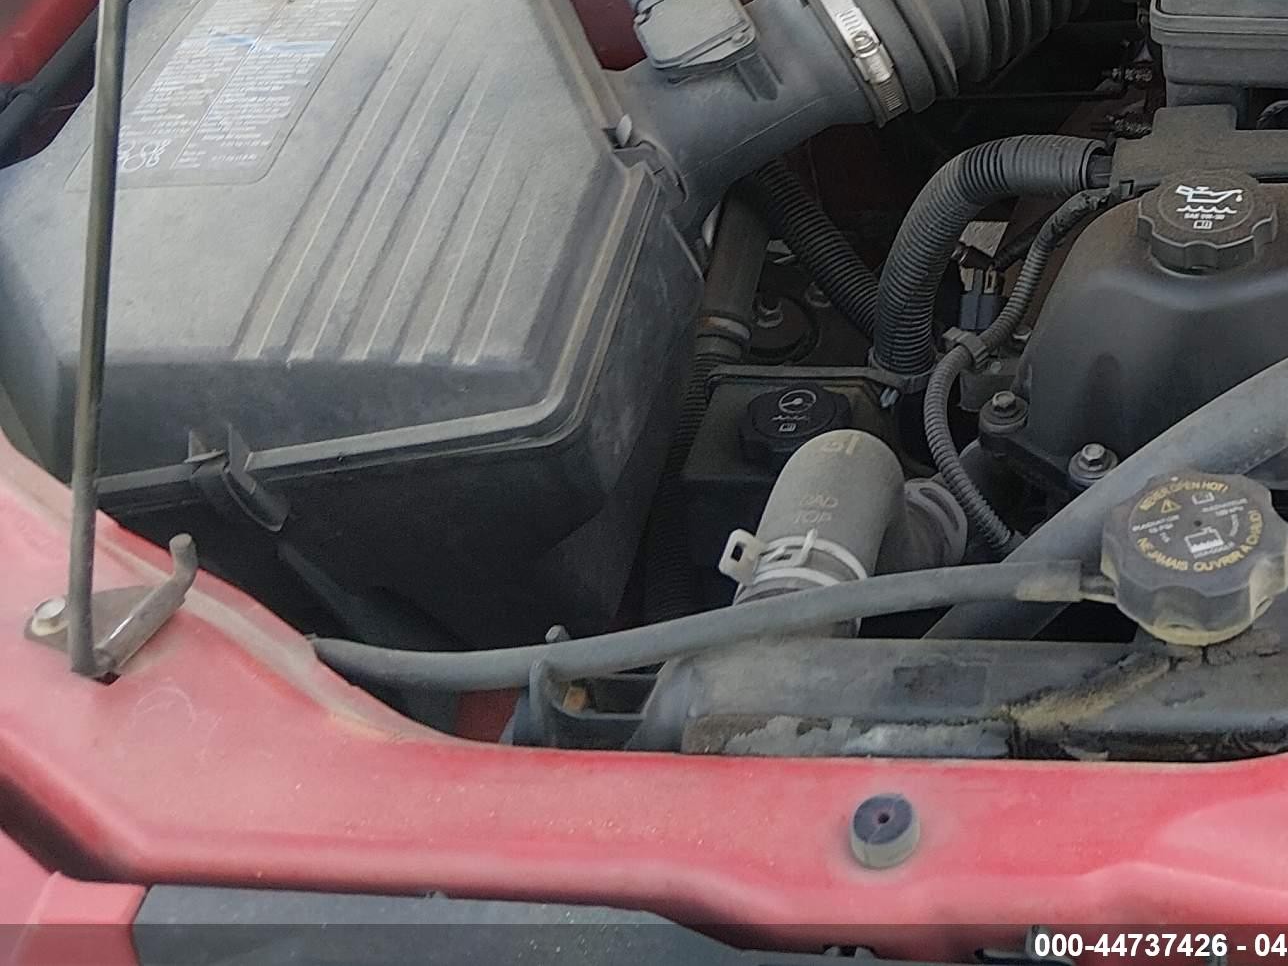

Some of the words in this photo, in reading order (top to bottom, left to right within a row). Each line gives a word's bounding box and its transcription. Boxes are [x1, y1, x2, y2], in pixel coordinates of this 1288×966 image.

[1169, 480, 1200, 492] OPEN
[1201, 480, 1229, 493] HOT!
[1147, 549, 1189, 571] JAMAIS
[1193, 550, 1245, 572] OUVRIR
